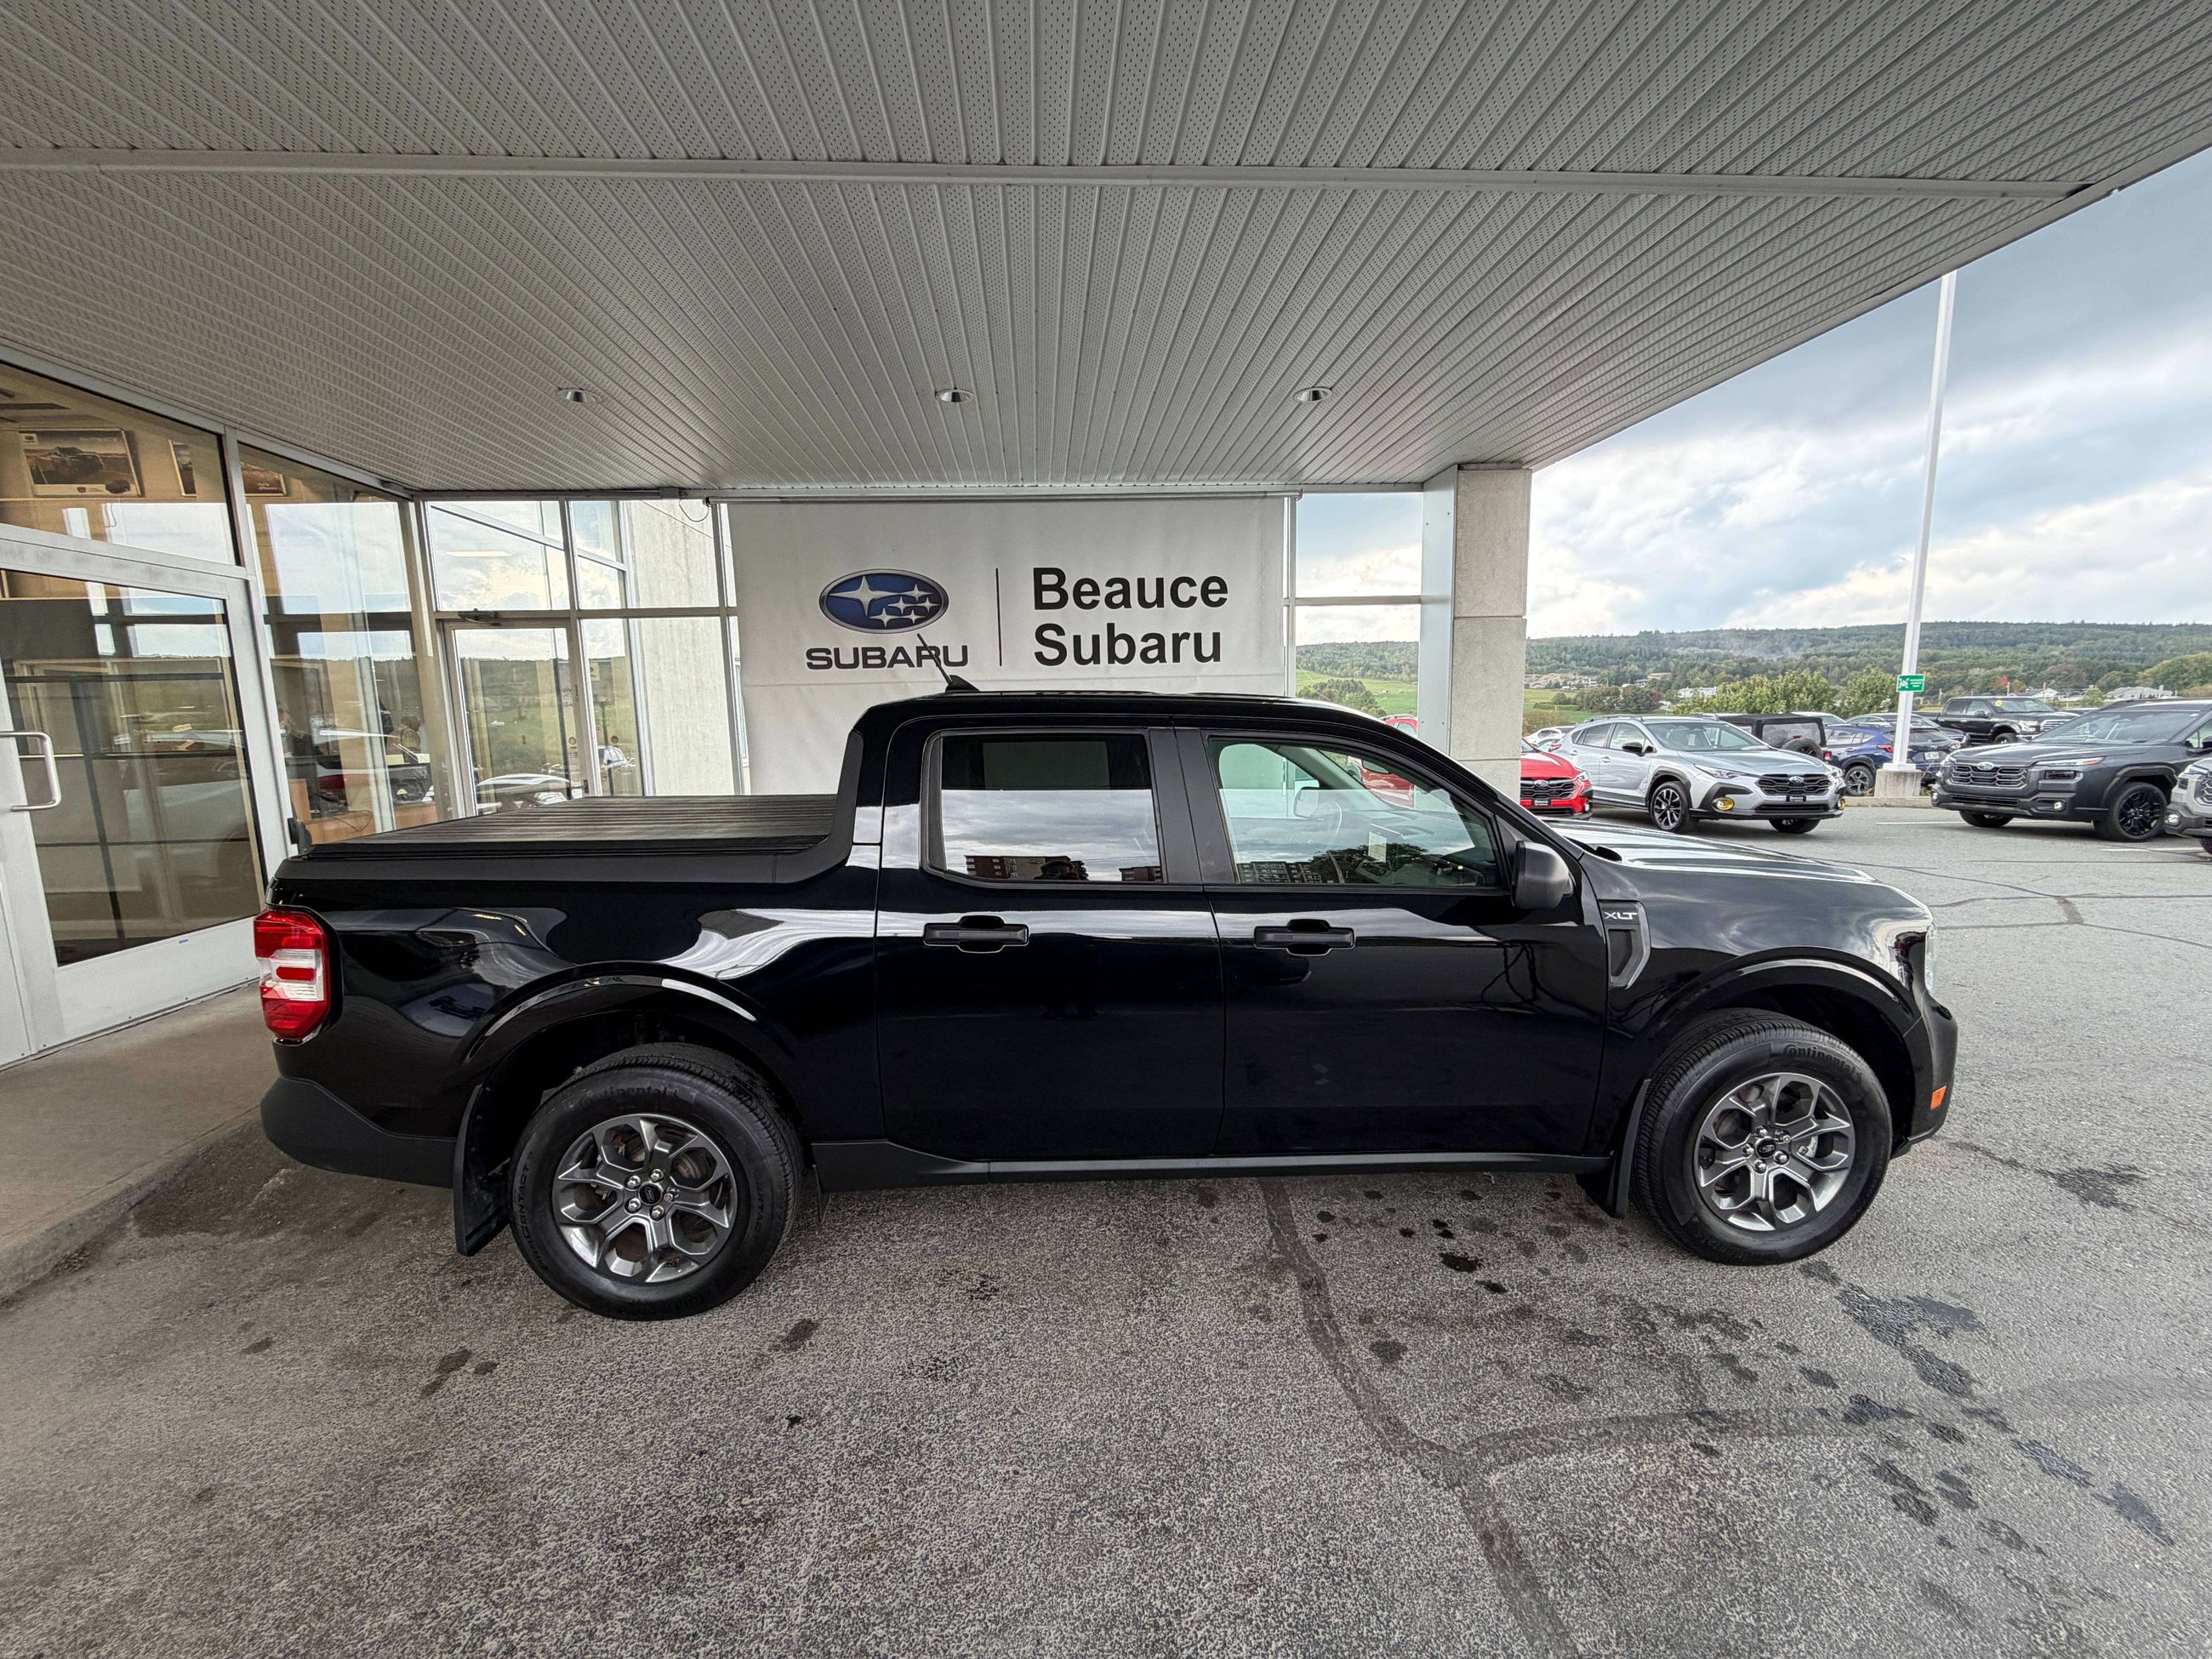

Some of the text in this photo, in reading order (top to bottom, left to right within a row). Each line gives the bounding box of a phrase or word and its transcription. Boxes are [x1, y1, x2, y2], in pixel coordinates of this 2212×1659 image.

[1033, 567, 1229, 610] Beauce
[806, 645, 968, 670] SUBARU
[1034, 623, 1221, 666] Subaru
